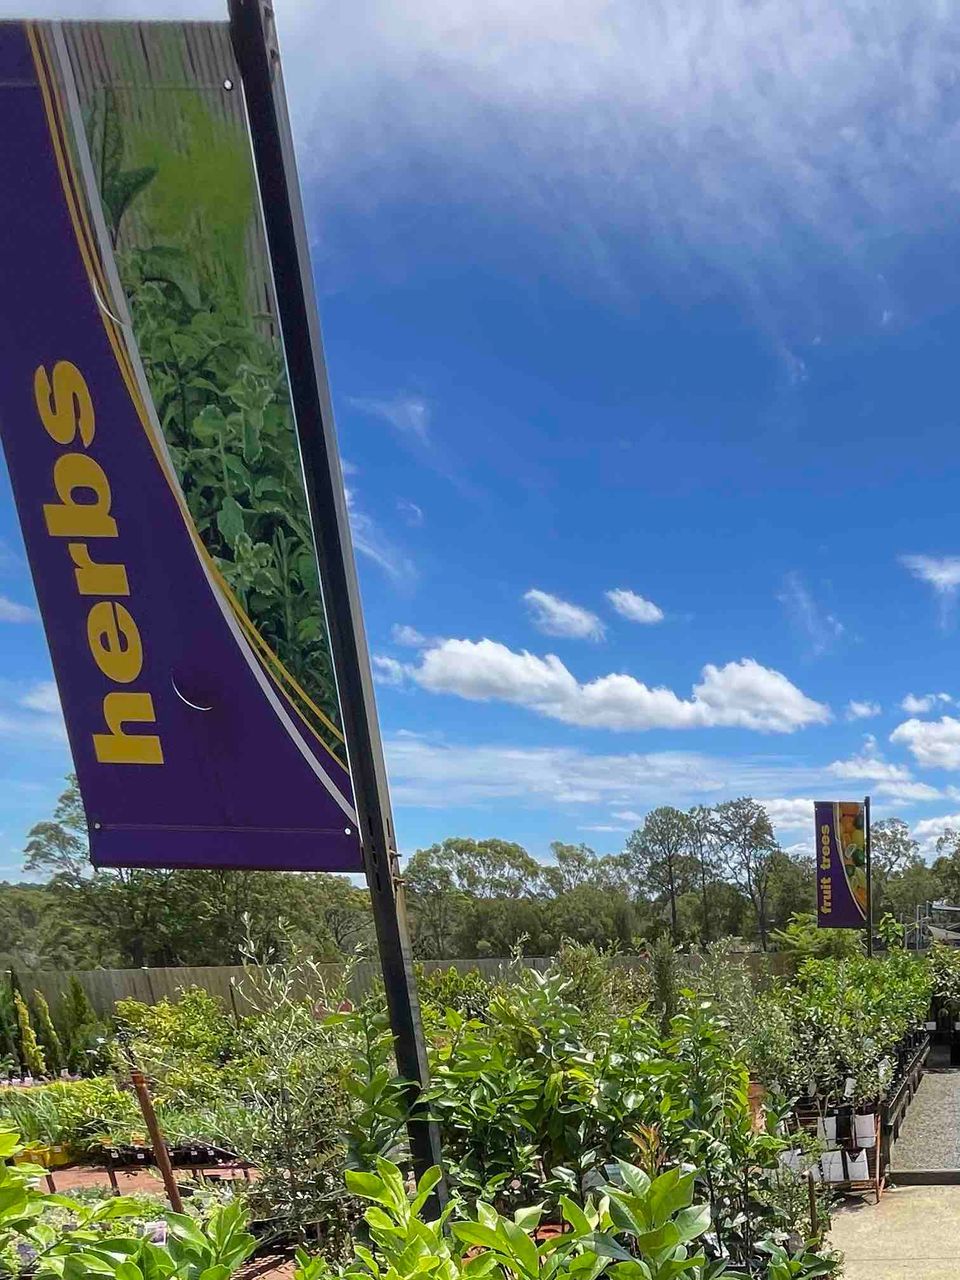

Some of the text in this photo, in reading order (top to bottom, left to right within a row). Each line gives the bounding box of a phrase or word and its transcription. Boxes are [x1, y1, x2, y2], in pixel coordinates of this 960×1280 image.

[34, 360, 165, 766] herbs
[820, 824, 832, 915] fruit trees
